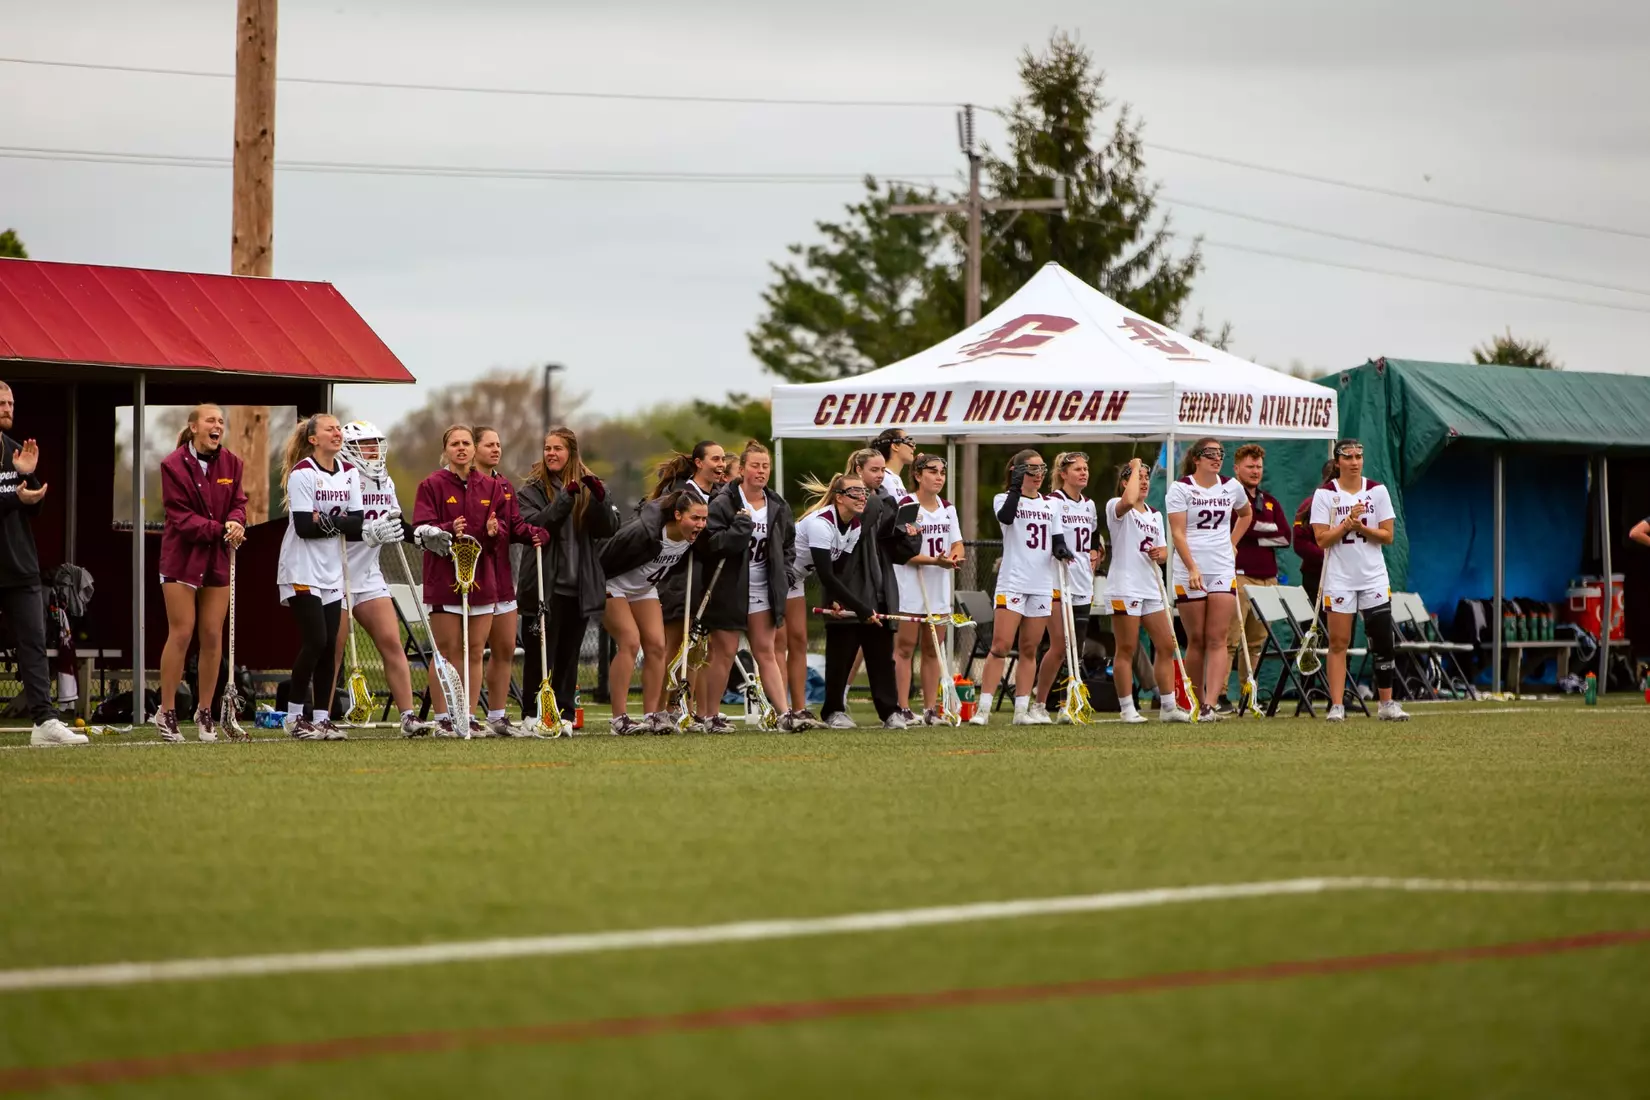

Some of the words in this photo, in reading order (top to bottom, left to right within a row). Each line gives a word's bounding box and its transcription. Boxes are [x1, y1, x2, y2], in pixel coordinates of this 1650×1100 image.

[813, 390, 953, 426] CENTRAL
[962, 389, 1130, 425] MICHIGAN
[1178, 391, 1254, 424] CHIPPEWAS
[1258, 394, 1332, 428] ATHLETICS
[1191, 496, 1231, 507] CHIPPEWAS
[921, 523, 950, 534] HIPPEWAS
[1196, 509, 1226, 530] 27
[1026, 522, 1047, 551] 31
[1074, 526, 1091, 553] 12
